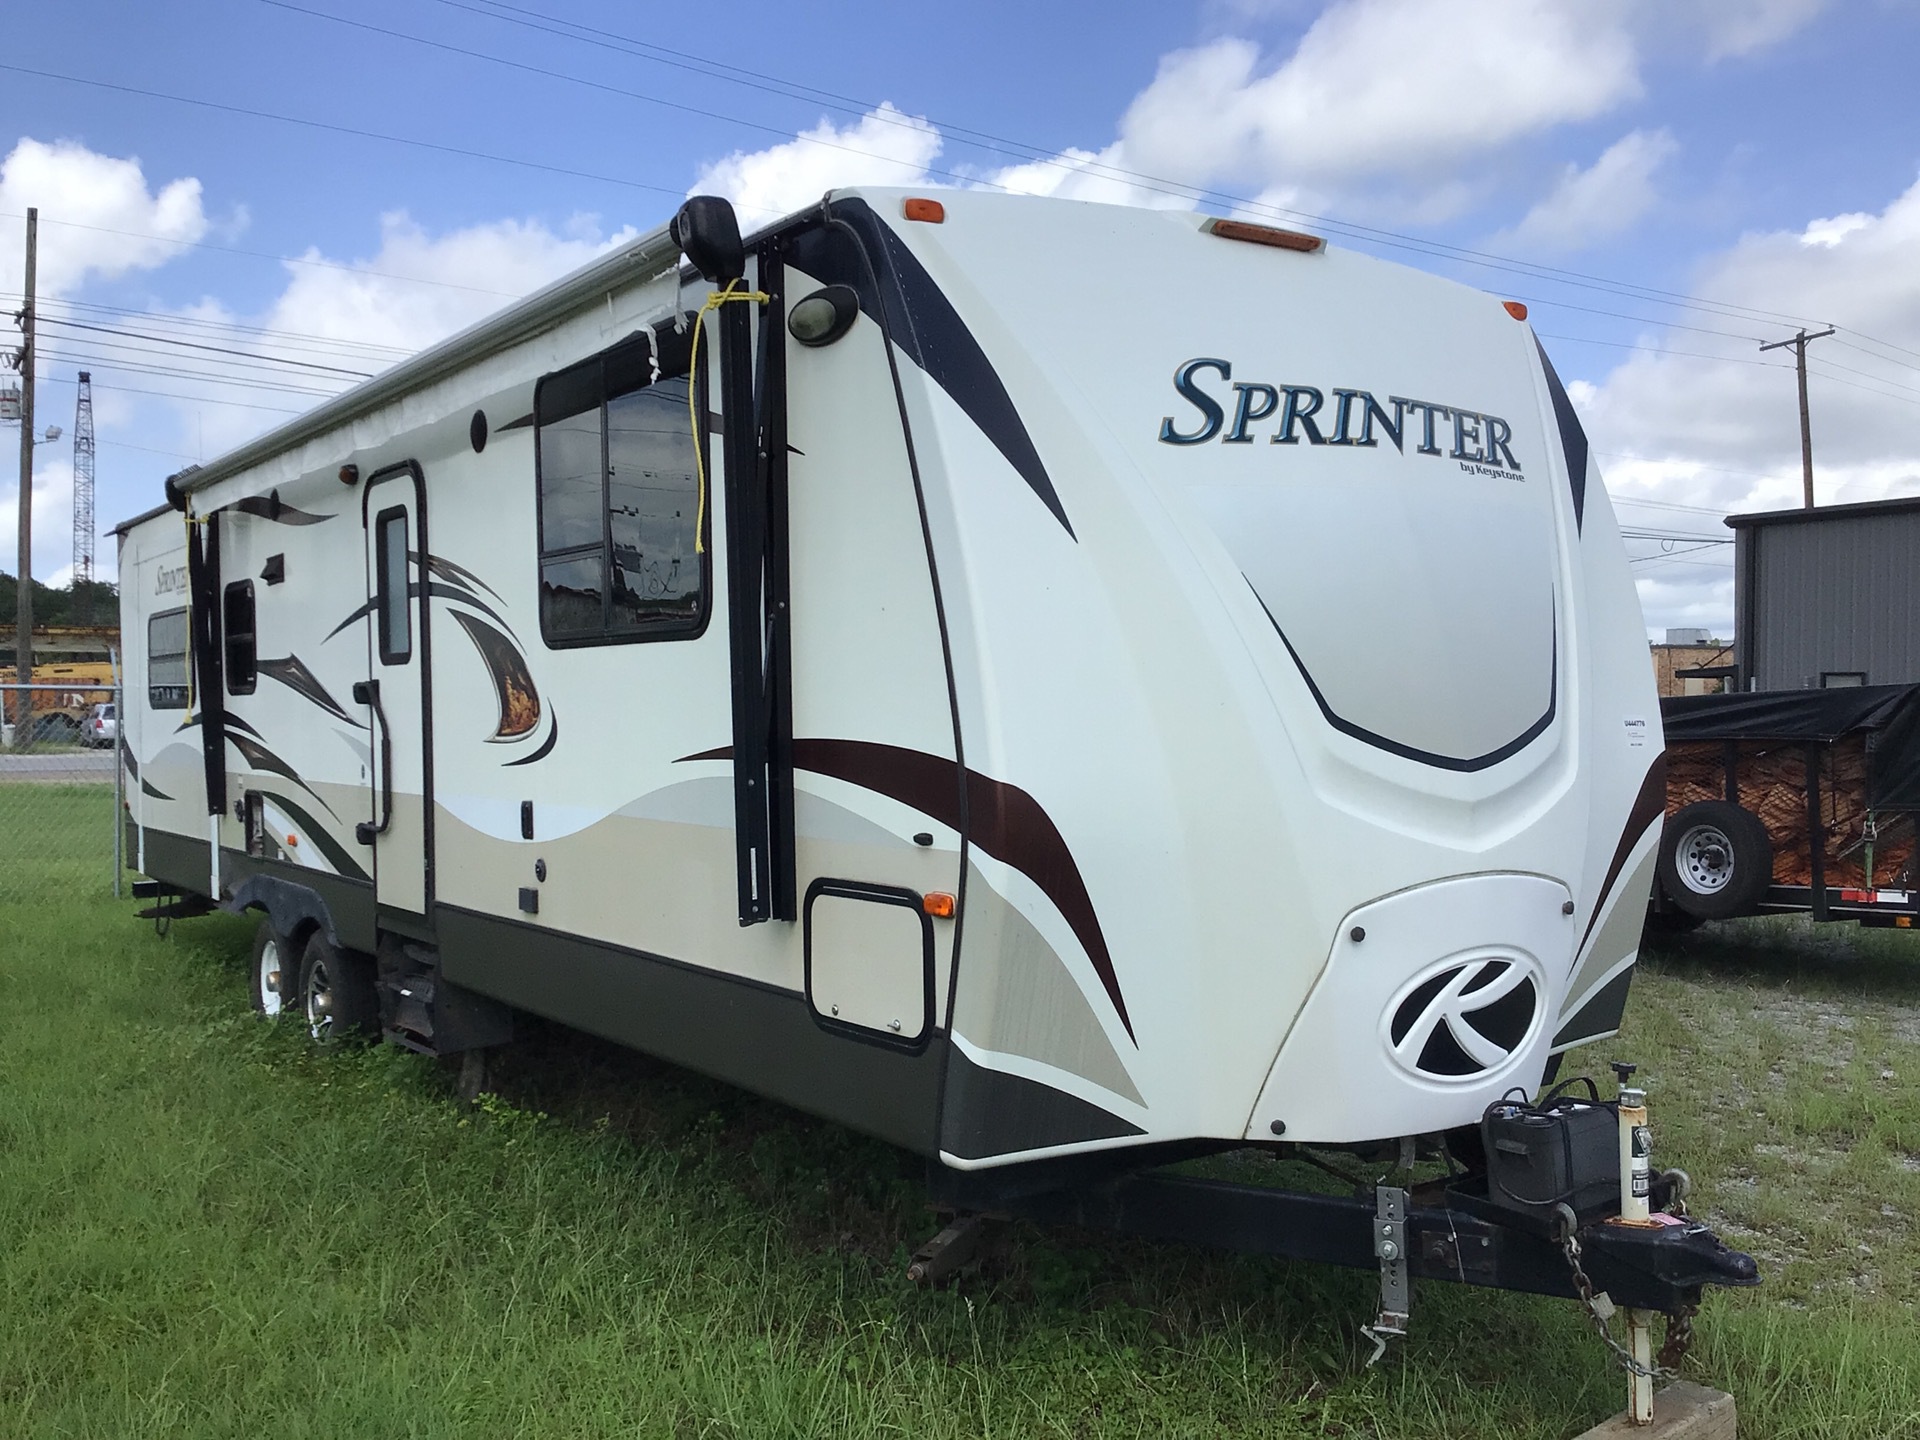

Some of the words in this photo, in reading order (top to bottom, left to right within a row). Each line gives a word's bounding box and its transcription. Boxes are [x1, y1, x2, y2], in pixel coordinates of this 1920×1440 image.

[1158, 357, 1521, 472] SPRINTER
[1460, 461, 1475, 475] by
[1475, 464, 1525, 482] Keystone
[155, 565, 187, 596] SPRINTE
